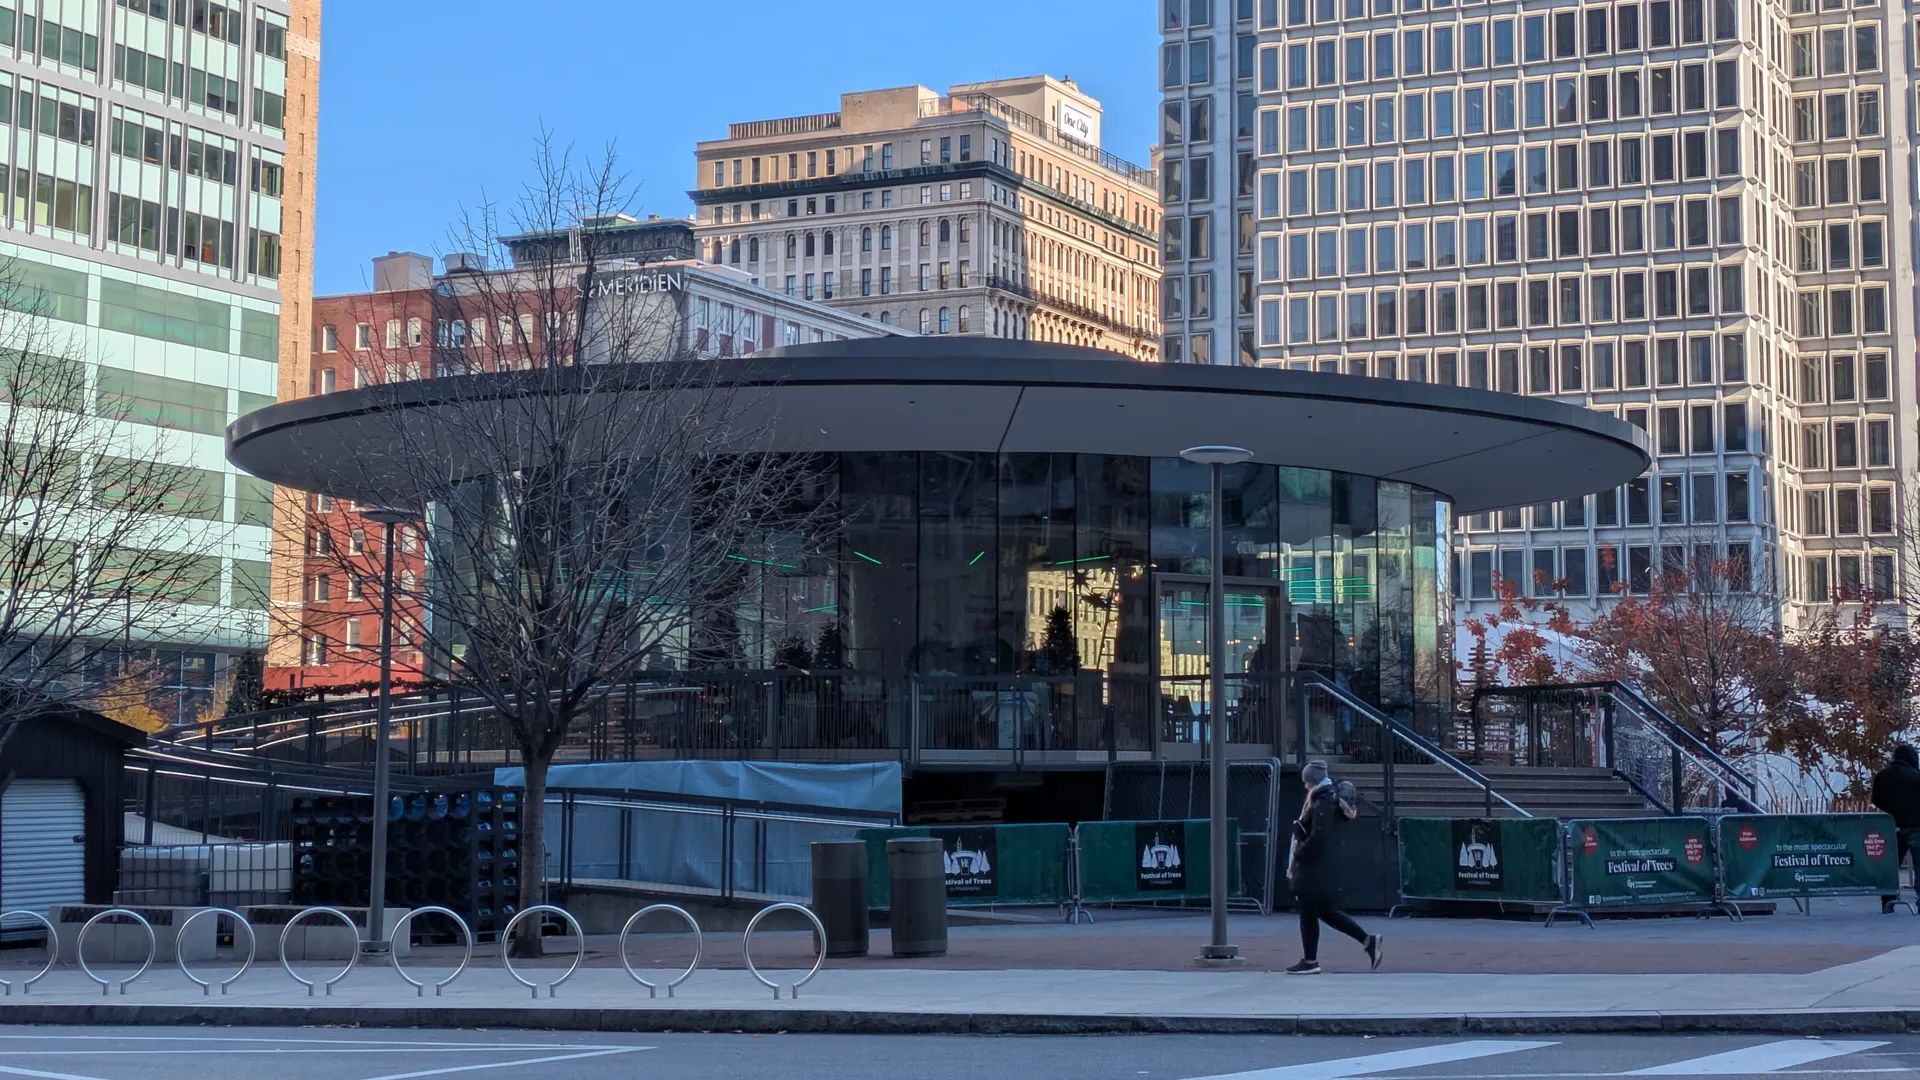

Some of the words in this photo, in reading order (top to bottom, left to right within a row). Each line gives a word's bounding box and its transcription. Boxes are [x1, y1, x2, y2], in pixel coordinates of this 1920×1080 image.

[1064, 112, 1075, 128] One
[1077, 118, 1088, 138] City
[1641, 848, 1669, 857] spectacular
[1811, 843, 1847, 852] spectacular
[1608, 860, 1640, 873] Festival
[1641, 860, 1650, 871] of
[1650, 859, 1674, 871] Trees
[1774, 854, 1809, 866] Festival
[1811, 854, 1821, 865] of
[1824, 854, 1850, 865] Trees
